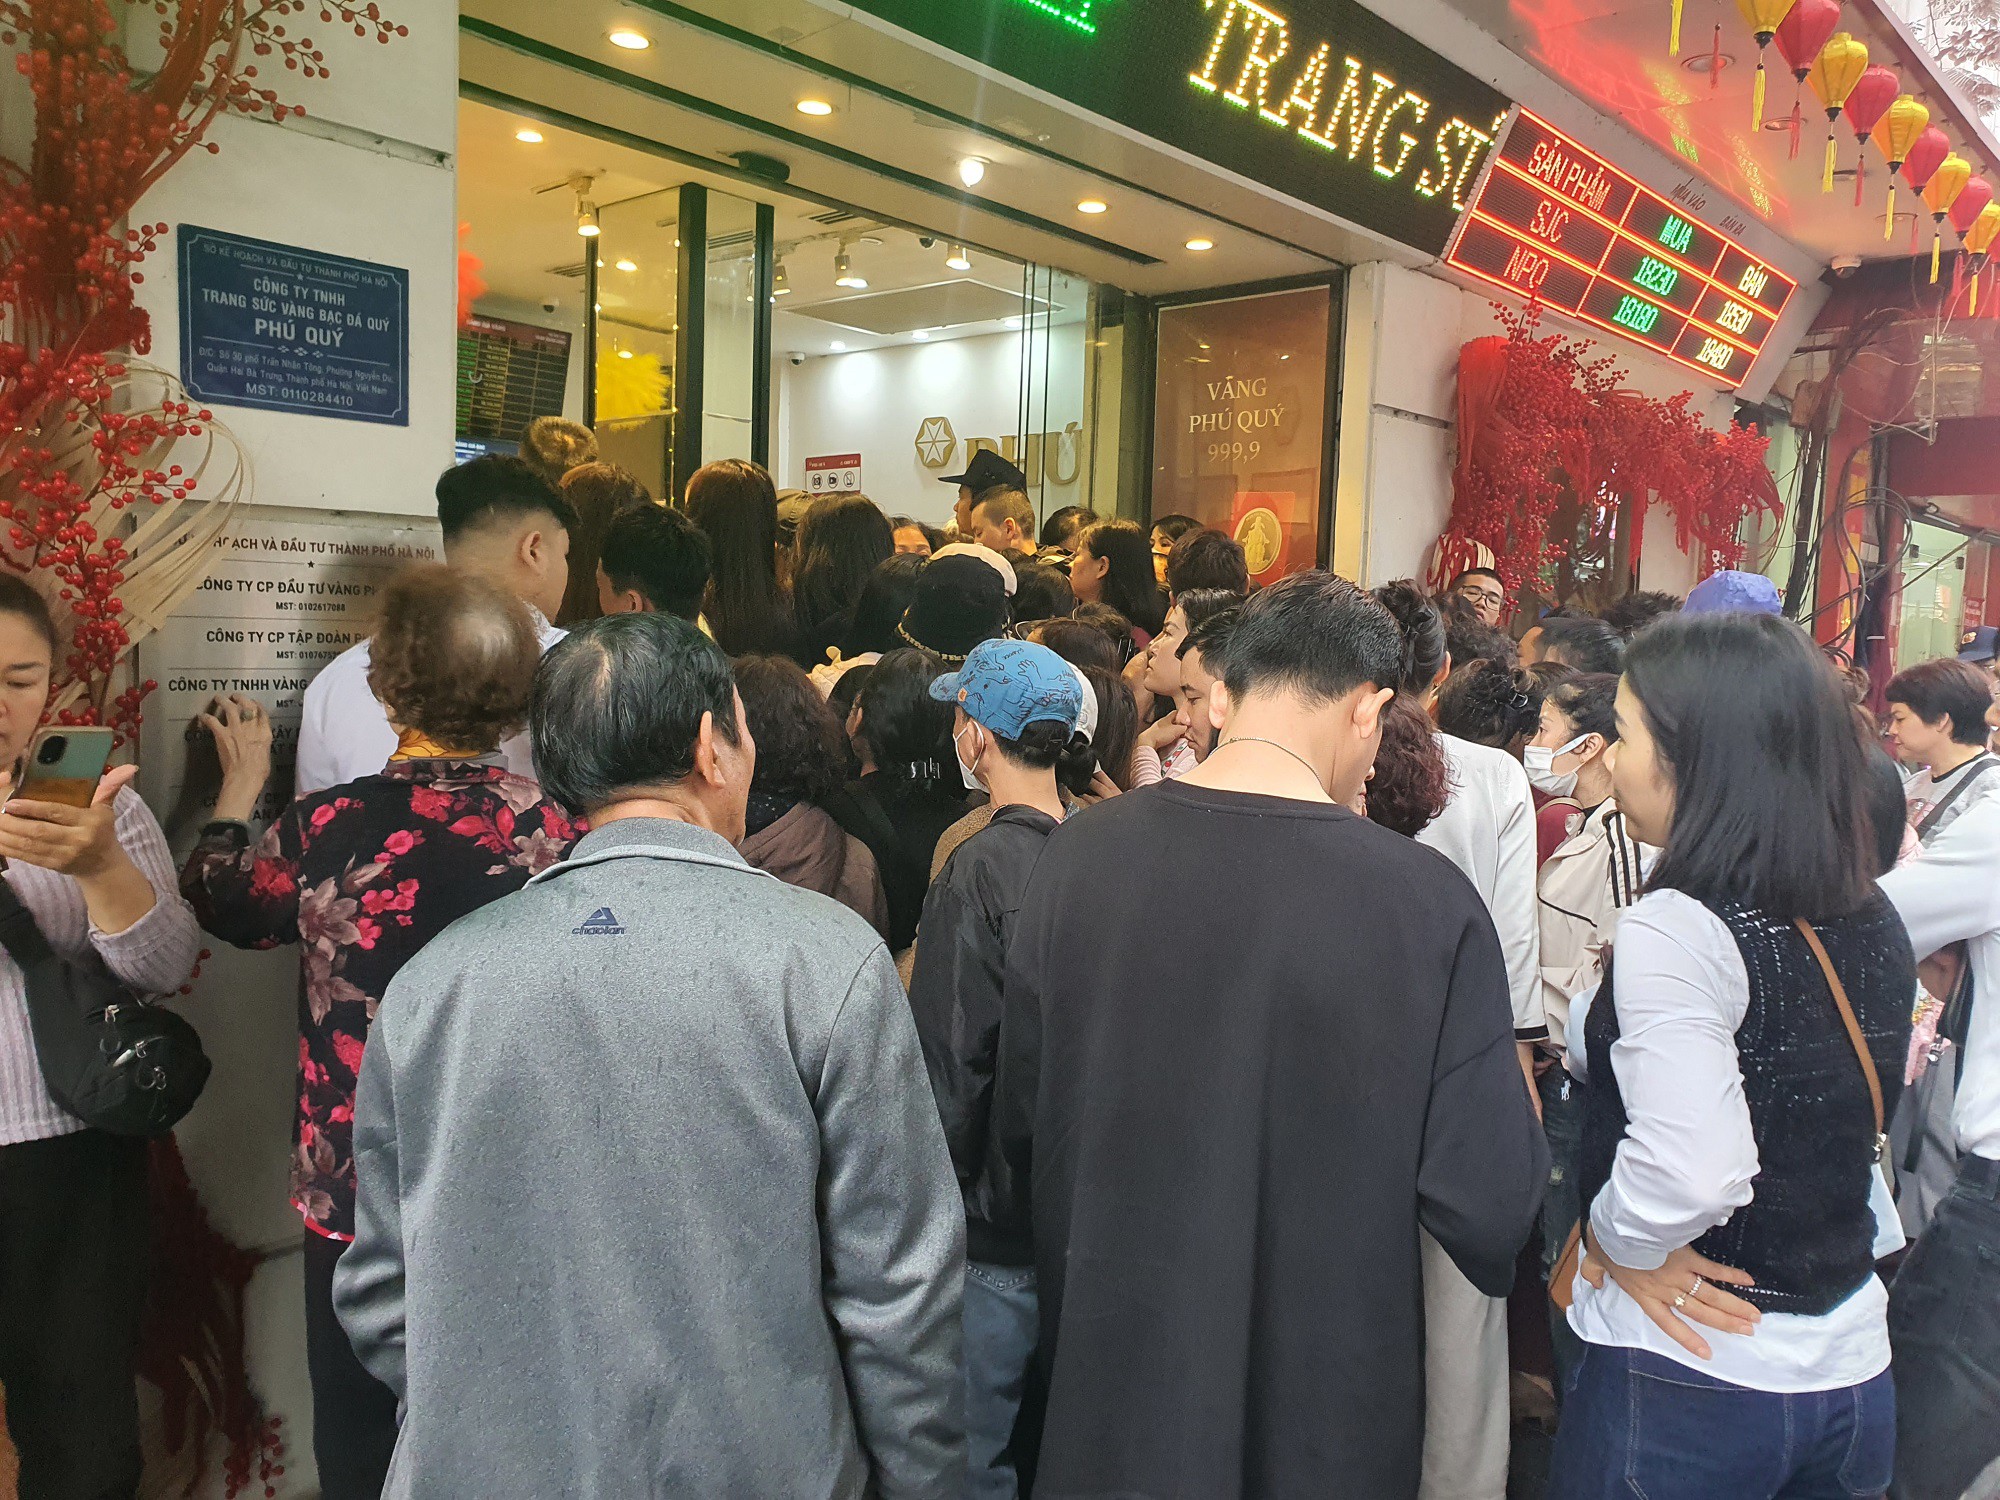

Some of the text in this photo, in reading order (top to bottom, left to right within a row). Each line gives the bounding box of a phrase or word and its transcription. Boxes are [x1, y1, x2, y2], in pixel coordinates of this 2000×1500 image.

[1189, 0, 1429, 179] TRANG
[1530, 199, 1569, 242] SJC
[1659, 214, 1693, 254] MUA
[1503, 246, 1549, 289] NPQ
[1633, 255, 1678, 296] 18230
[1738, 264, 1768, 299] BÁN
[253, 276, 346, 307] CÔNG TY TNHH
[202, 288, 390, 332] TRANG SỨC VÀNG BẠC ĐÁ QUÝ
[1612, 294, 1659, 333] 18180
[255, 319, 344, 347] PHÚ QUÝ
[246, 382, 353, 406] MST: 0110284410
[1189, 403, 1286, 434] PHÚ QUÝ
[1208, 441, 1261, 464] 999,9
[261, 537, 278, 551] VÀ
[281, 537, 306, 552] ĐẦU
[310, 541, 326, 553] TƯ
[328, 541, 369, 556] THÀNH
[372, 543, 395, 557] PHỐ
[398, 545, 413, 558] HÀ
[416, 546, 435, 560] NỘI
[196, 575, 233, 591] ÔNG
[237, 580, 253, 592] TY
[257, 581, 274, 593] CP
[278, 578, 304, 594] ĐẦU
[308, 582, 325, 595] TƯ
[327, 581, 360, 596] VÀNG
[276, 602, 346, 612] MST: 0102617088
[206, 627, 244, 643] CÔNG
[248, 632, 264, 643] TY
[268, 631, 285, 643] CP
[288, 629, 313, 645] TẬP
[316, 630, 351, 644] ĐOÀN
[276, 651, 297, 659] MST:
[168, 676, 308, 691] CÔNG TY TNHH VÀNG
